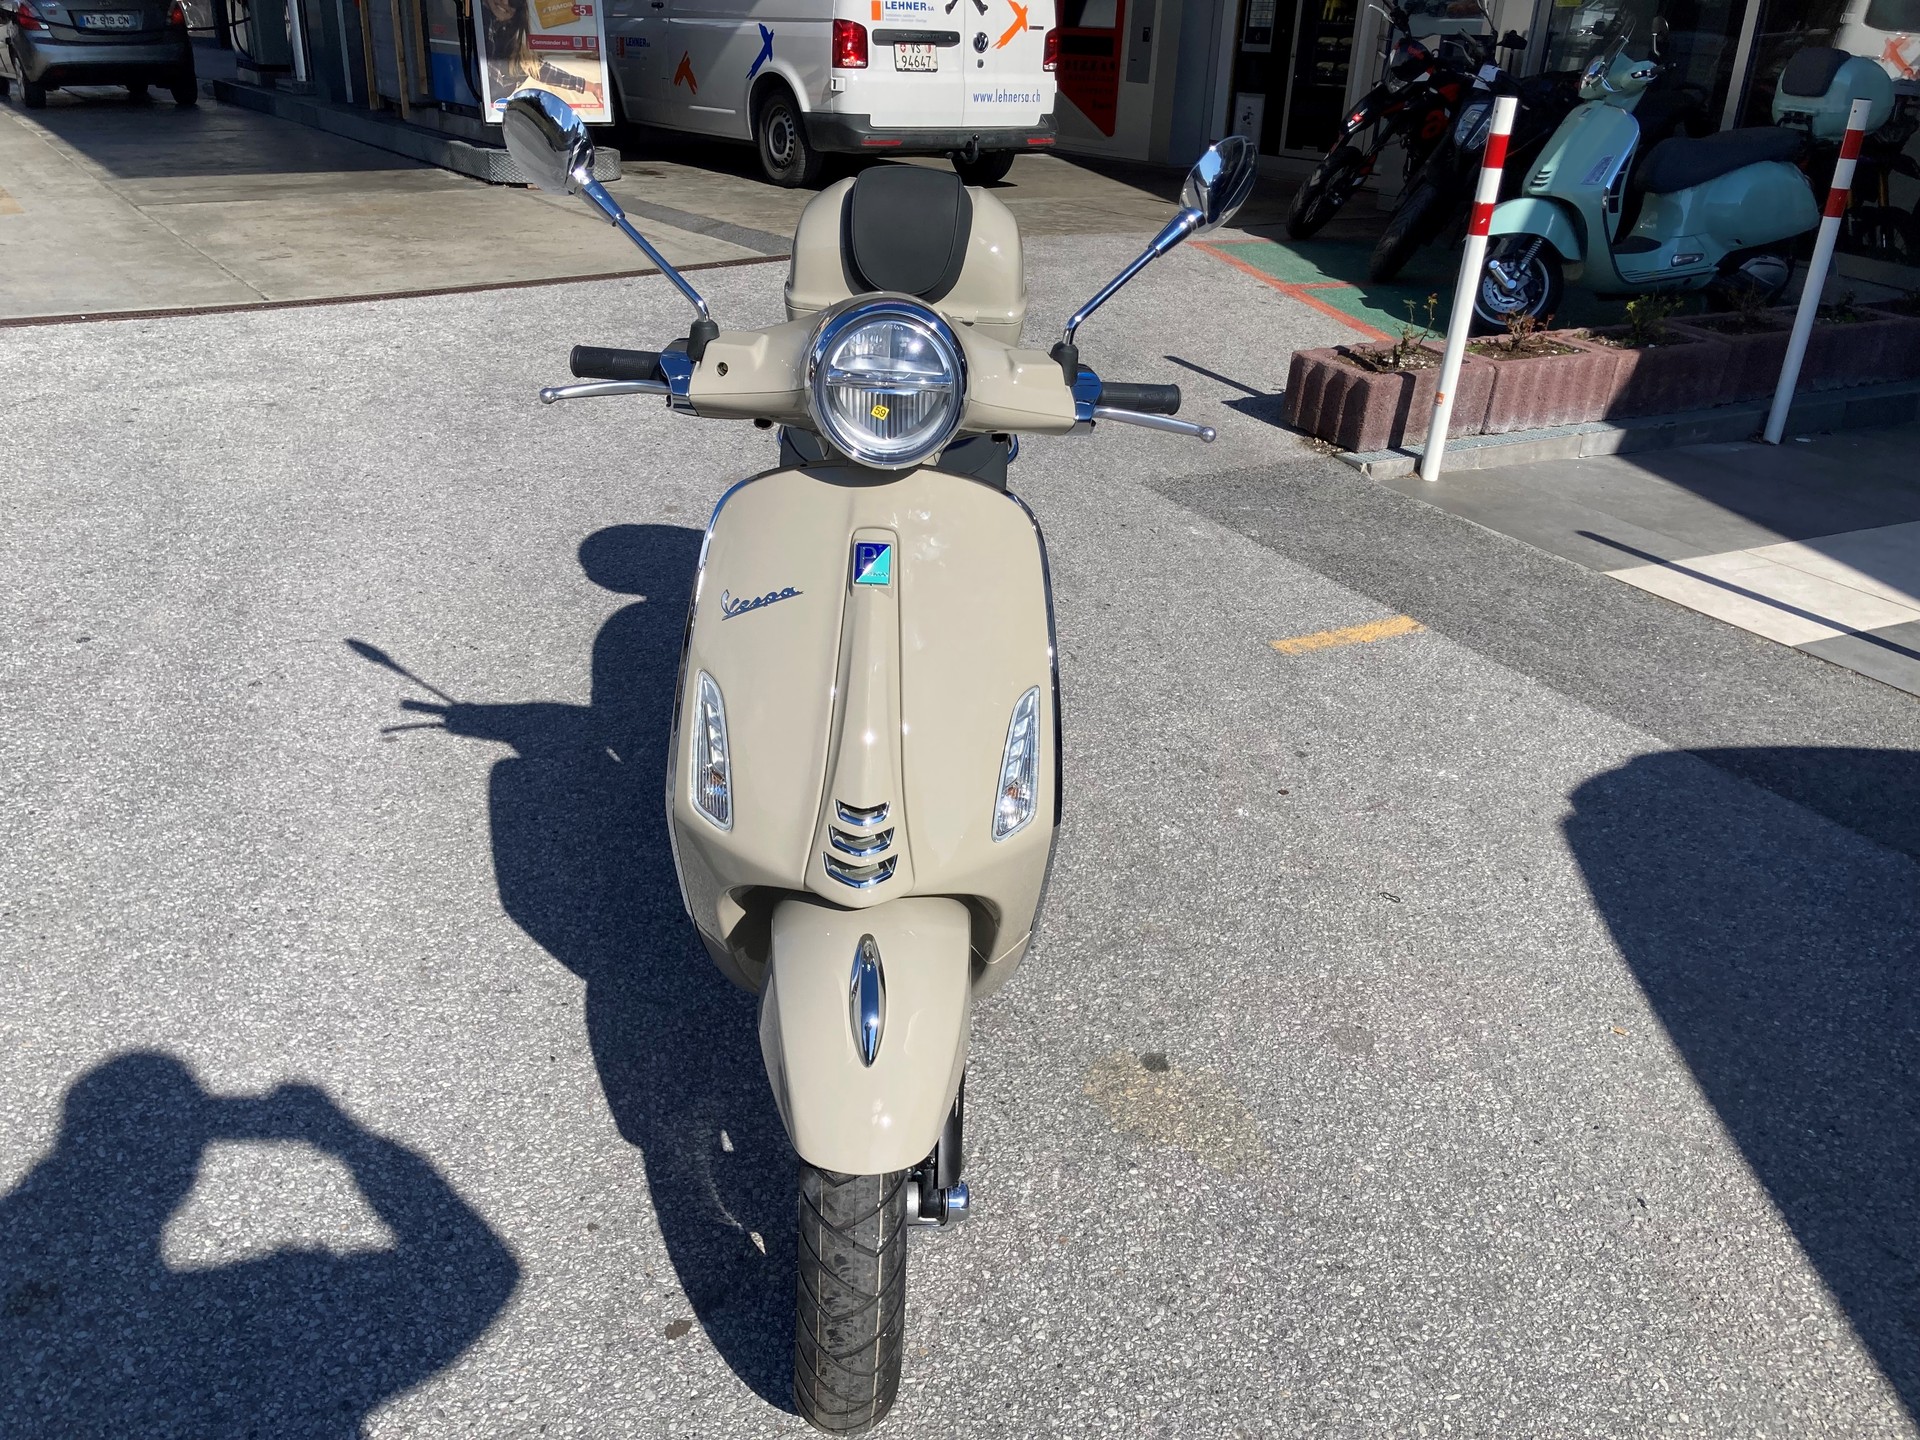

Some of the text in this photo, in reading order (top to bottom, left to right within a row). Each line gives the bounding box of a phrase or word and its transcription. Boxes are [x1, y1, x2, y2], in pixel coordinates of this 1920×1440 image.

[885, 1, 927, 11] LEHNER
[86, 16, 130, 25] AZ 919 CN
[910, 44, 921, 53] VS
[901, 55, 931, 68] 94647
[973, 88, 1041, 103] www.lehnersa.ch
[873, 405, 887, 418] 59
[721, 586, 804, 621] Vespa
